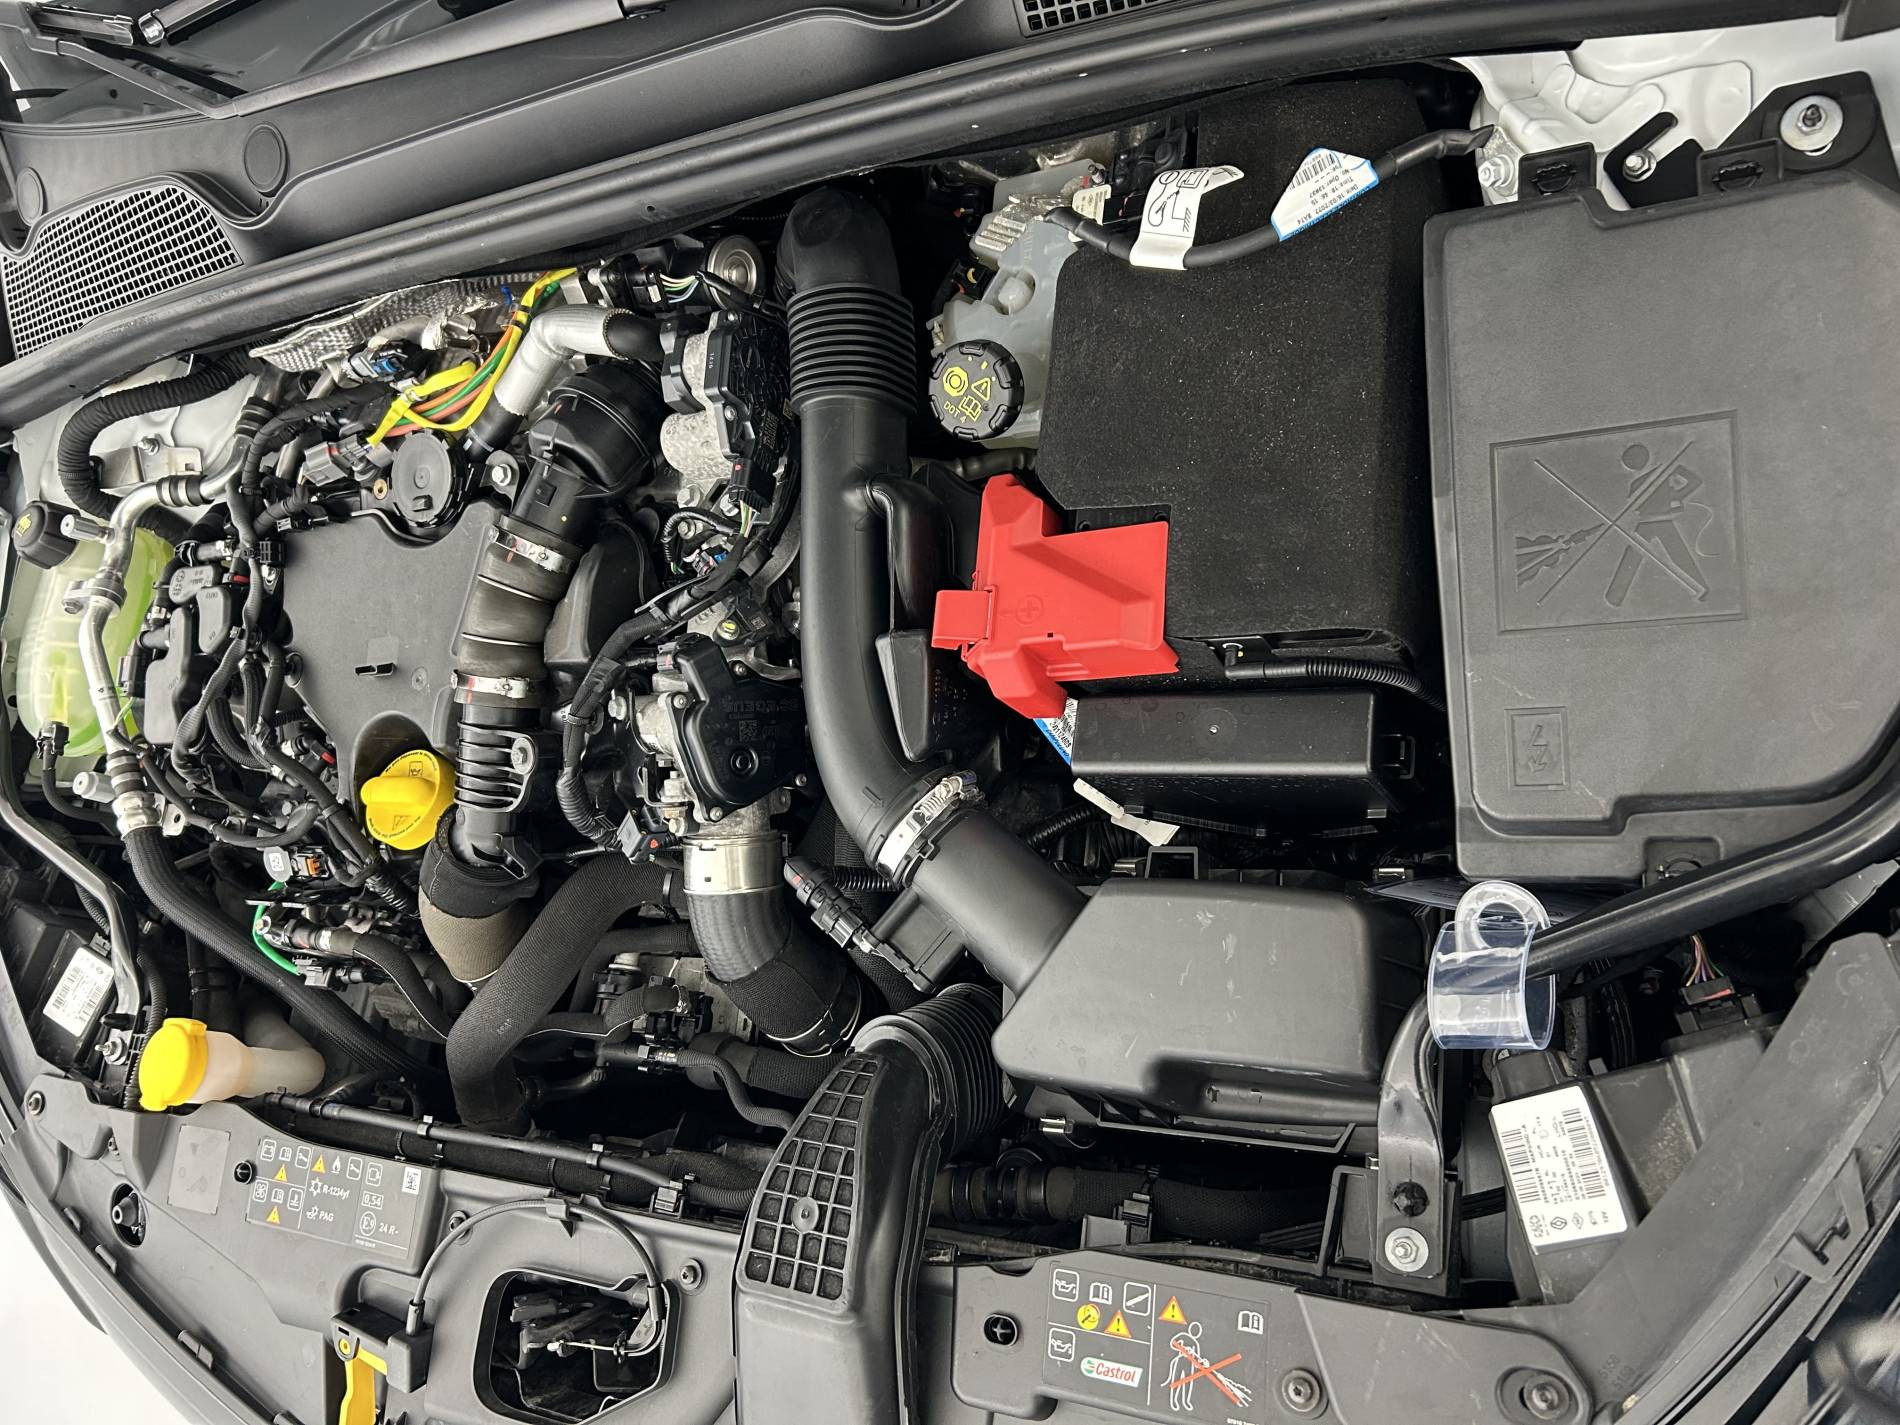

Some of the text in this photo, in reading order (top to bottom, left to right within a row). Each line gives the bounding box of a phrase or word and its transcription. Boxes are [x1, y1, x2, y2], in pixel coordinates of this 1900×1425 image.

[944, 401, 967, 424] DOT 4
[322, 1184, 350, 1200] R-1234yf
[319, 1210, 334, 1222] PAG
[379, 1222, 388, 1233] 24
[1096, 1362, 1136, 1382] Castrol
